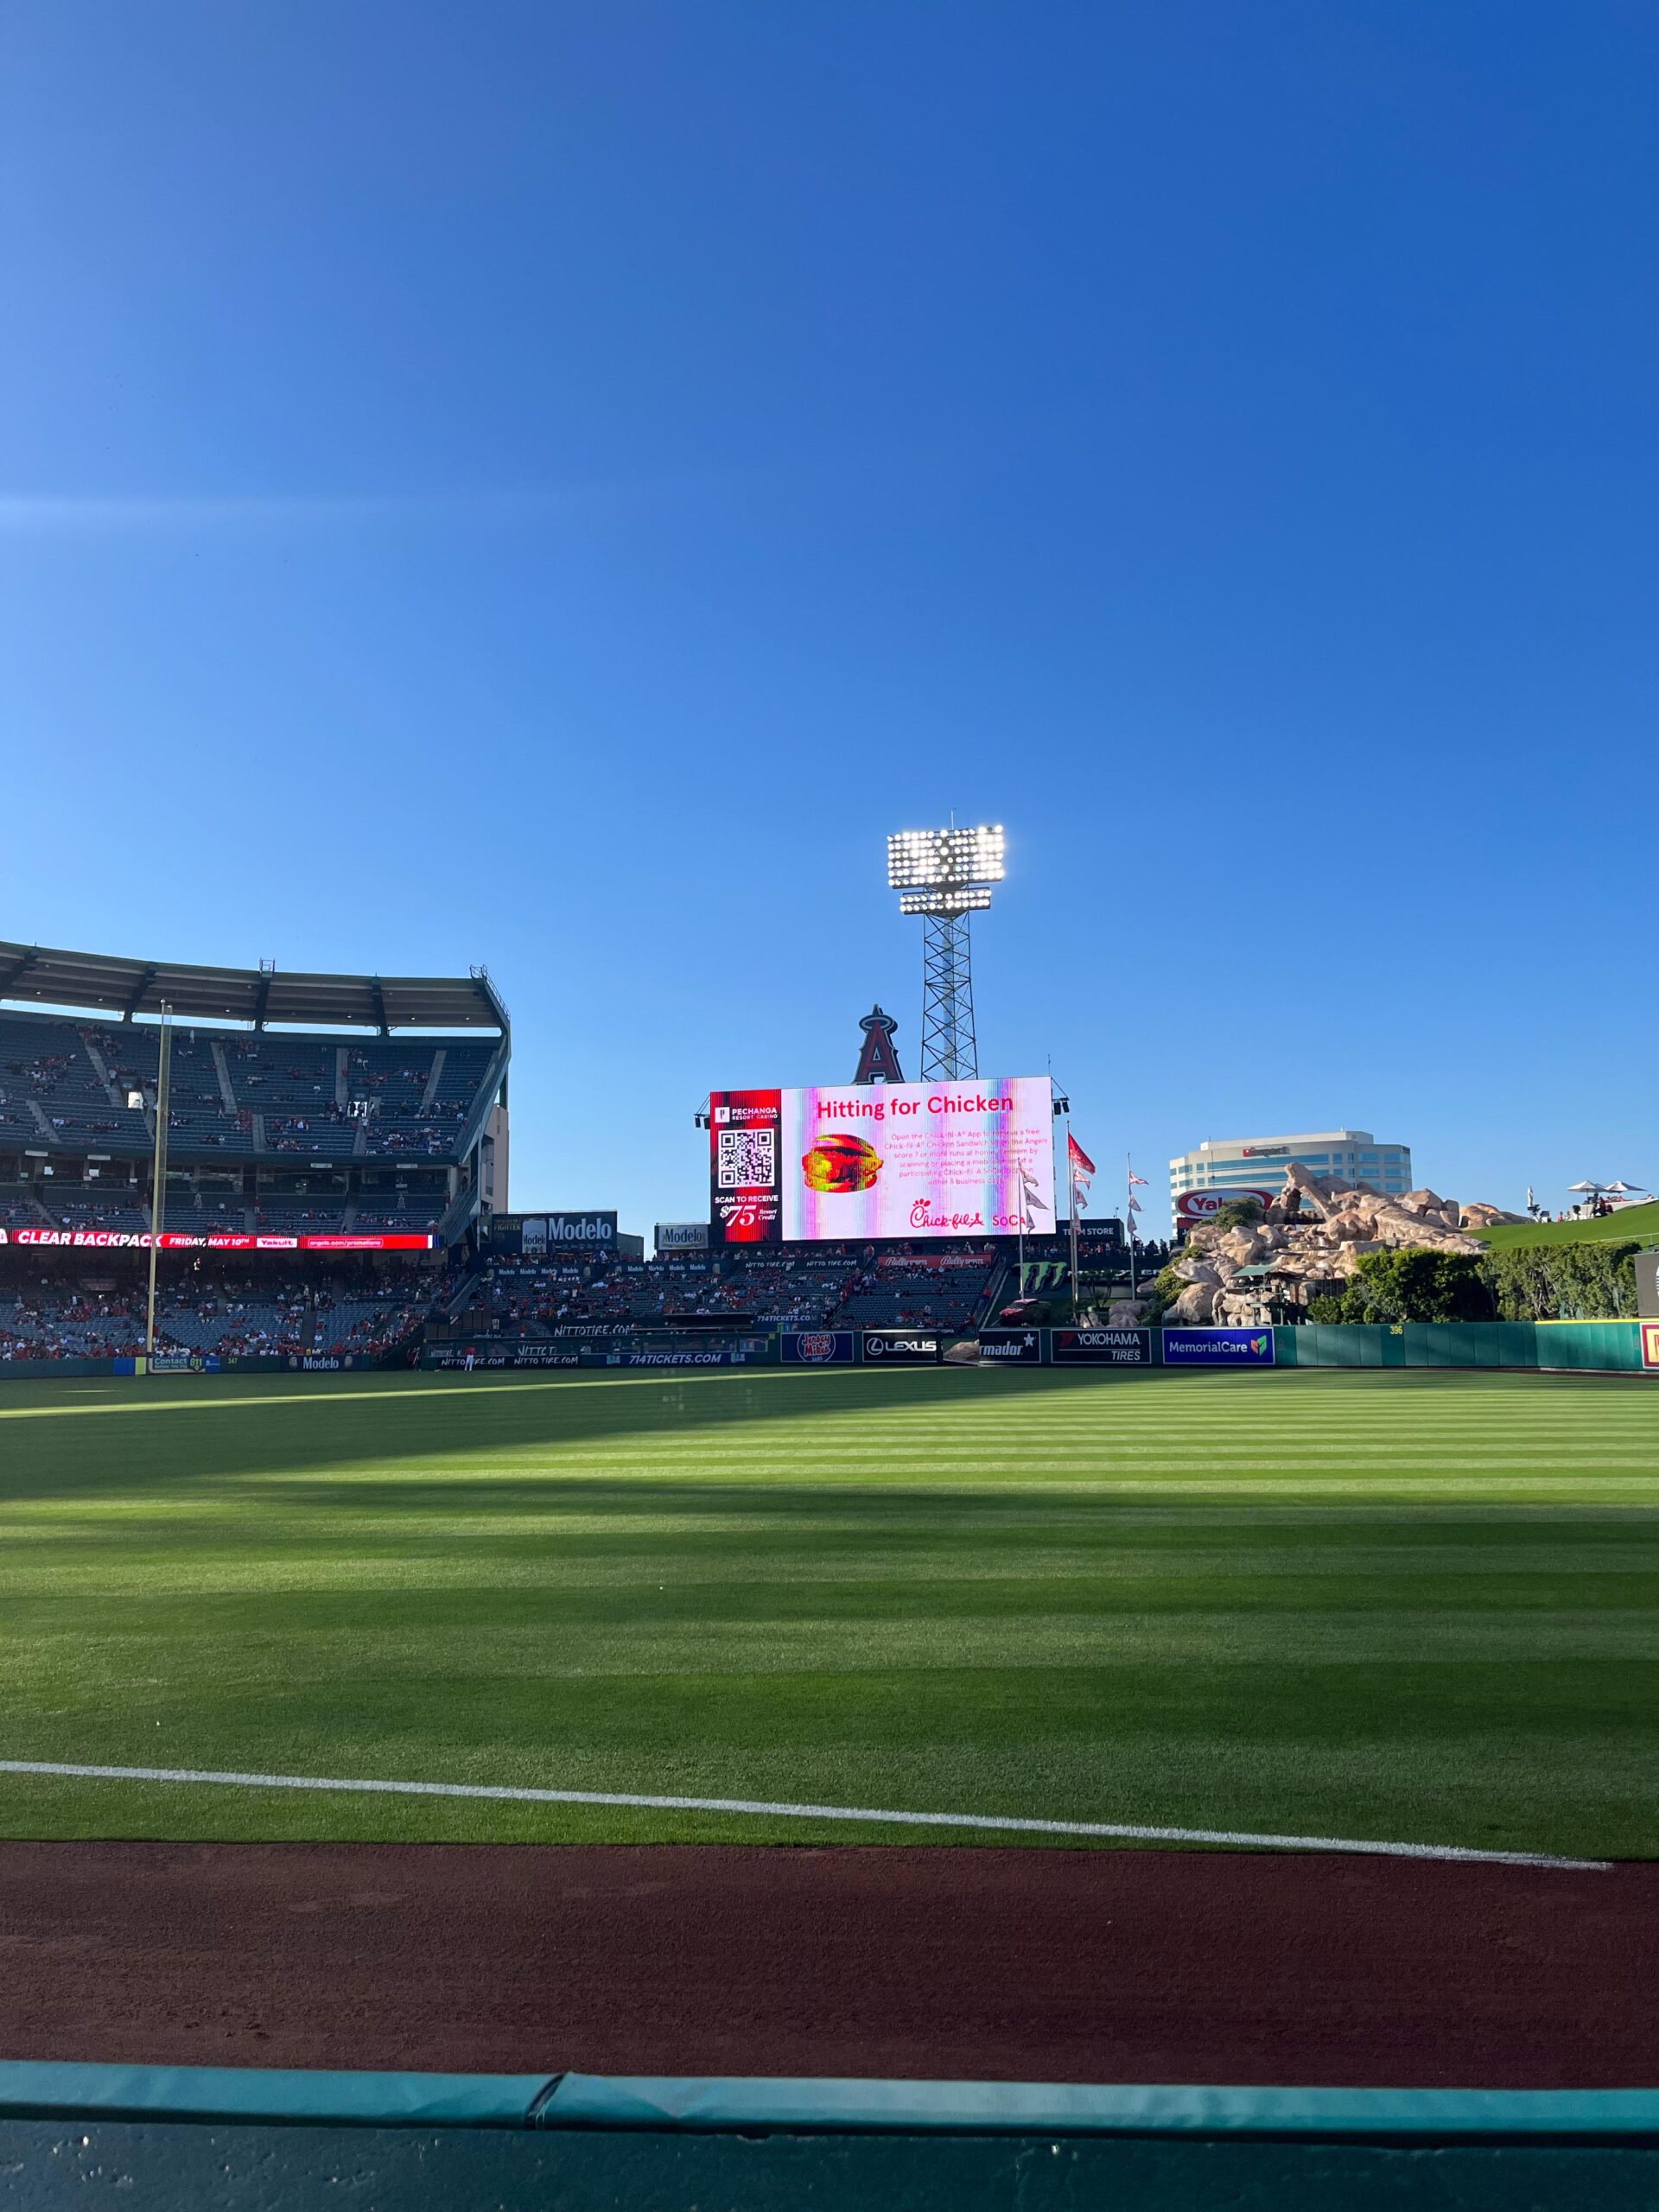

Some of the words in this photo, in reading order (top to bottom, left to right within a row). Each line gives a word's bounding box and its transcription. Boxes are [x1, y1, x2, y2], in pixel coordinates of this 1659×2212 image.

[732, 1107, 778, 1116] PECHANGA
[817, 1100, 885, 1121] Hitting
[891, 1098, 920, 1115] for
[927, 1095, 1014, 1113] Chicken
[1025, 1137, 1048, 1146] Angels
[1030, 1147, 1038, 1155] by
[720, 1205, 757, 1227] $75
[910, 1205, 984, 1230] Chick-fil-A
[548, 1217, 613, 1240] Modelo
[18, 1231, 72, 1245] CLEAR
[169, 1236, 207, 1248] FRIDAY,
[207, 1237, 230, 1246] MAY
[664, 1228, 702, 1243] Modelo
[1389, 1325, 1403, 1335] 396
[802, 1332, 831, 1345] Jersey
[1077, 1332, 1141, 1345] YOKOHAMA
[885, 1340, 938, 1351] LEXUS
[1169, 1341, 1248, 1352] MemorialCare
[514, 1357, 539, 1365] NITTO
[541, 1356, 579, 1365] TIRE.COM
[628, 1353, 722, 1364] 714TICKETS.COM
[1111, 1351, 1141, 1361] TIRES
[190, 1357, 203, 1367] 811
[302, 1356, 340, 1370] Modelo
